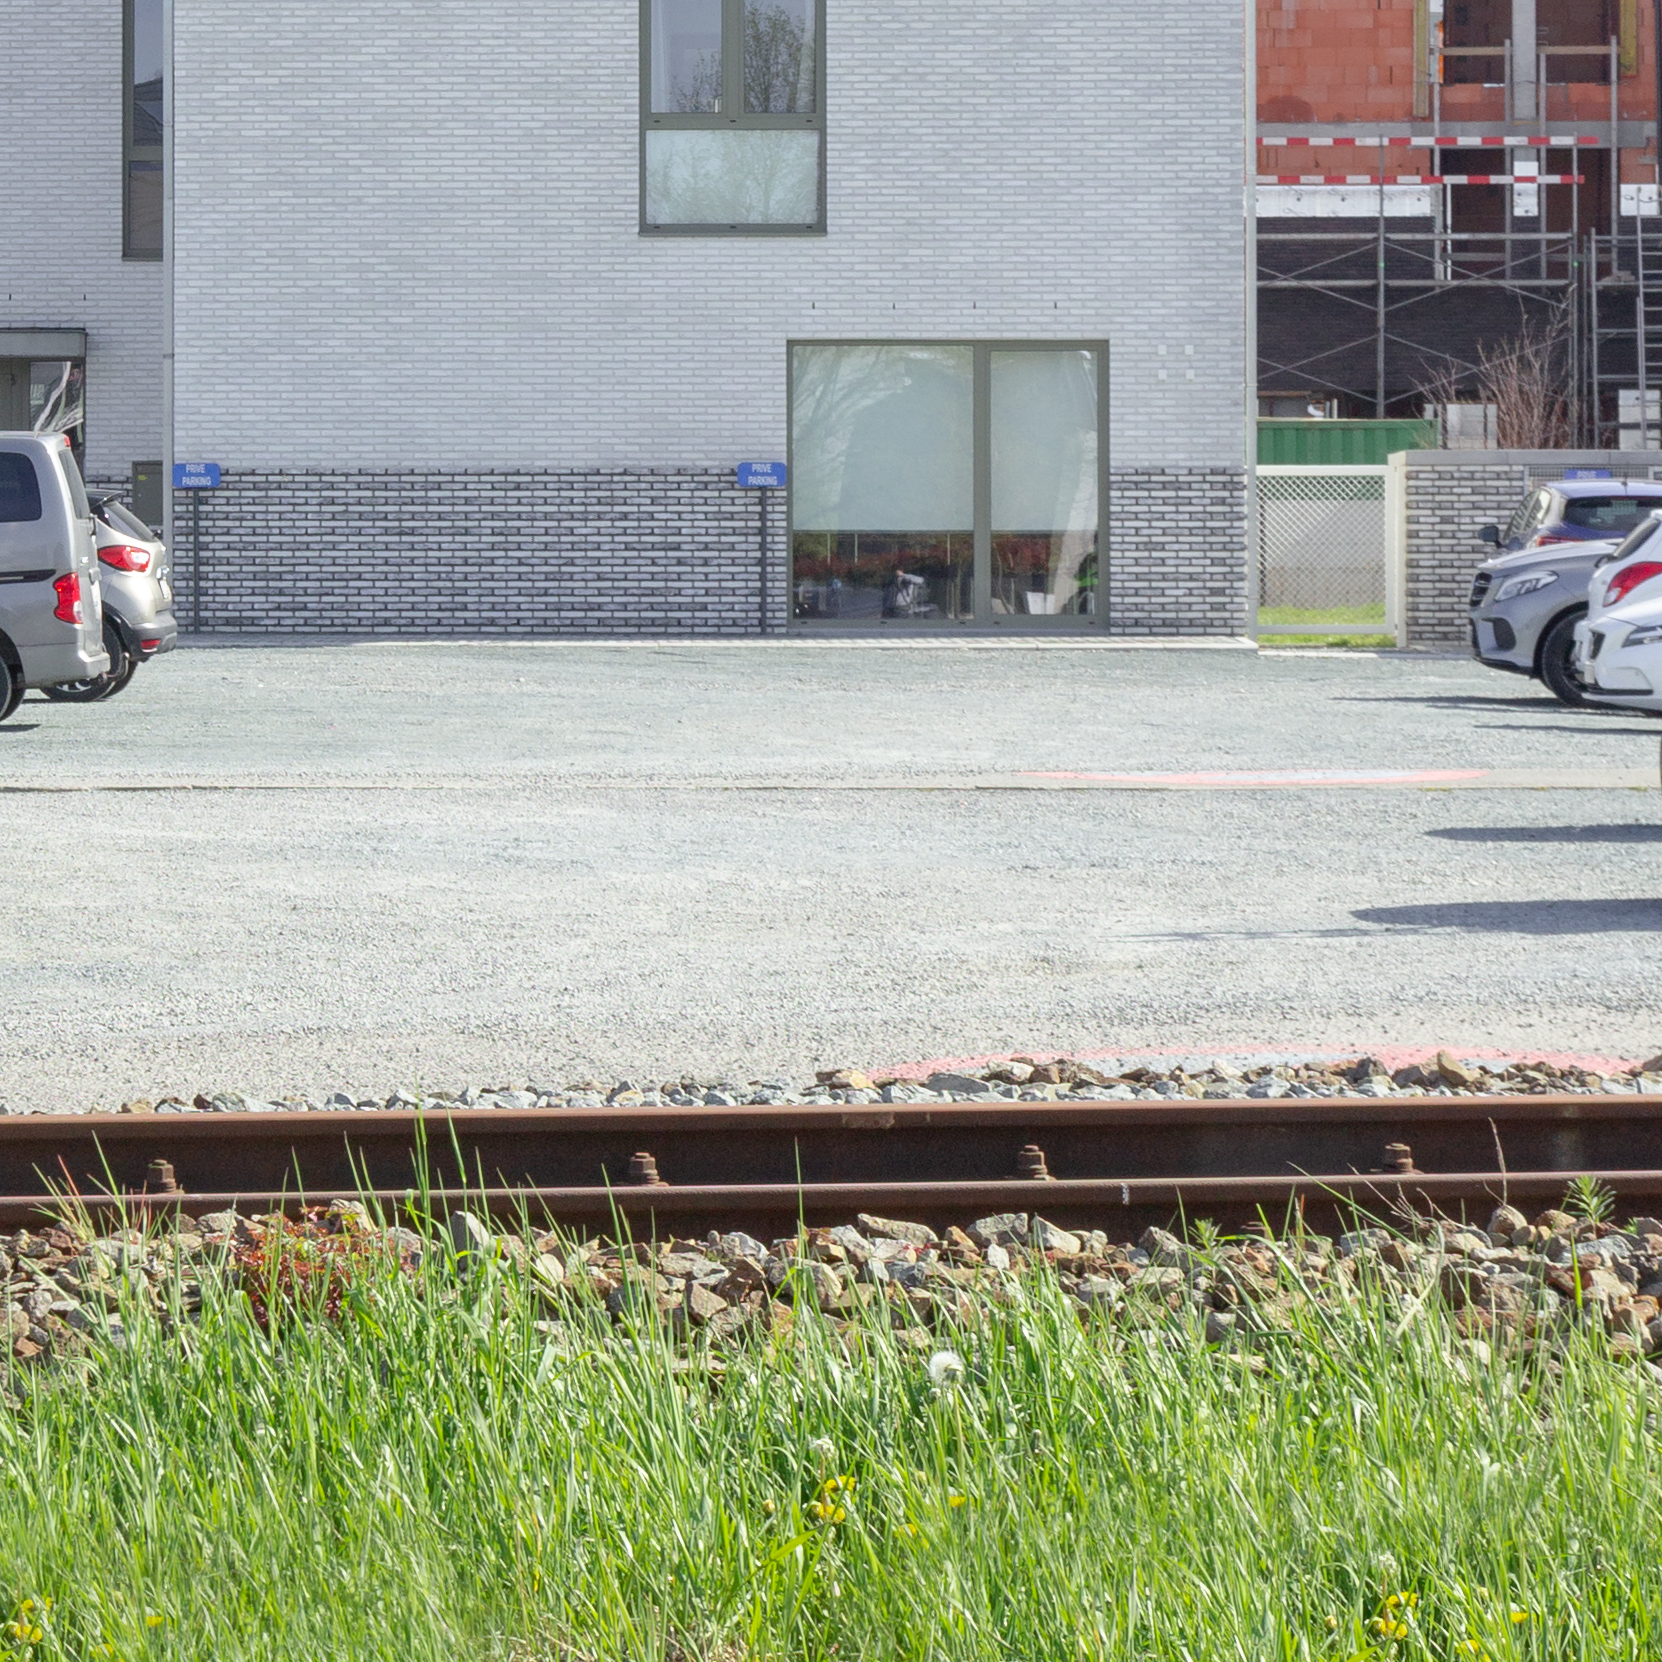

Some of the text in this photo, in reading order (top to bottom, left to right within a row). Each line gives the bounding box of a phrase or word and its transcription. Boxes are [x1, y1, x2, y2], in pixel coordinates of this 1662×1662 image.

[185, 464, 206, 474] PRIVE
[751, 463, 772, 473] PRIVE
[181, 476, 212, 486] PARKING
[748, 476, 778, 486] PARKING
